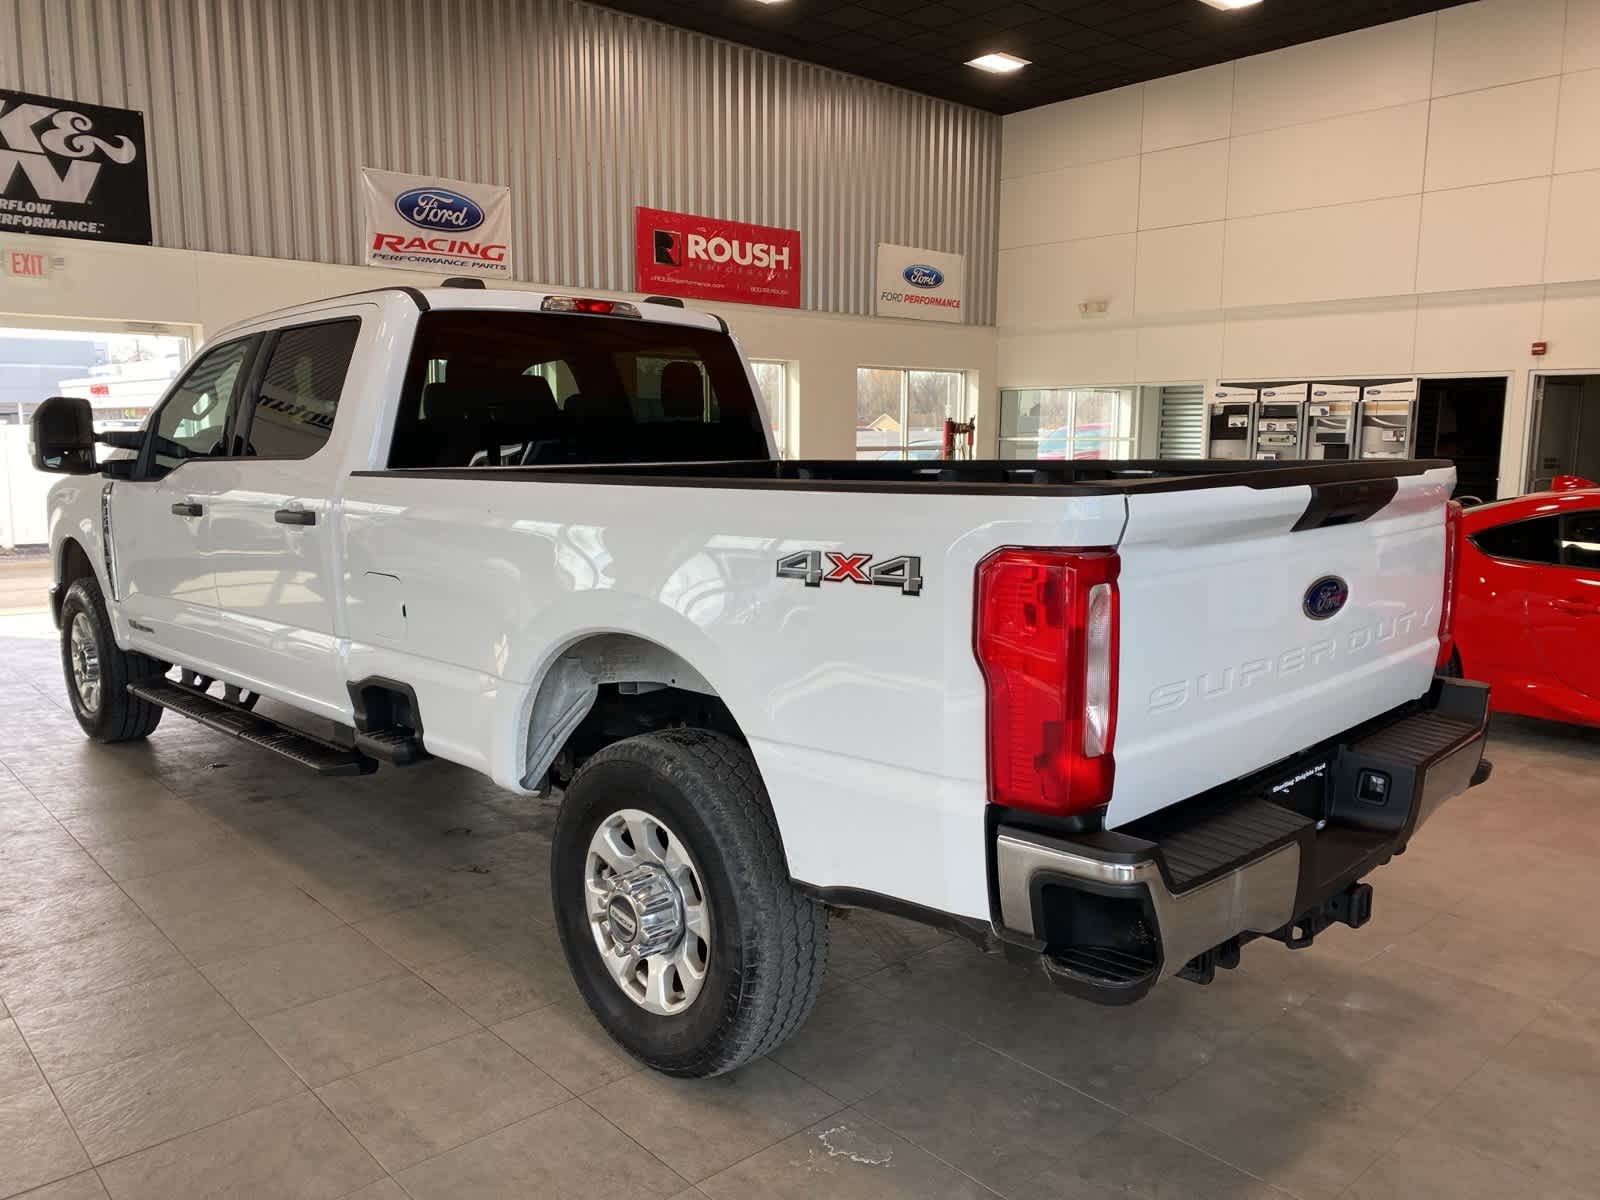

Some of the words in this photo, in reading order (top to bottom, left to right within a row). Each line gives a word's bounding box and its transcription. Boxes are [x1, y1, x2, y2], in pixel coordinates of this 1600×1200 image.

[413, 194, 468, 226] Ford
[0, 213, 102, 234] RFORMANCE.
[373, 233, 506, 261] RACING
[687, 233, 790, 270] ROUSH
[11, 252, 44, 276] EXIT
[372, 253, 470, 267] PERFORMANCE
[471, 262, 507, 271] PARTS
[911, 267, 936, 285] Ford
[881, 291, 903, 303] FORD
[904, 293, 961, 309] PERFORMANCE
[1146, 640, 1337, 715] SUPER
[1349, 599, 1435, 653] DUTY
